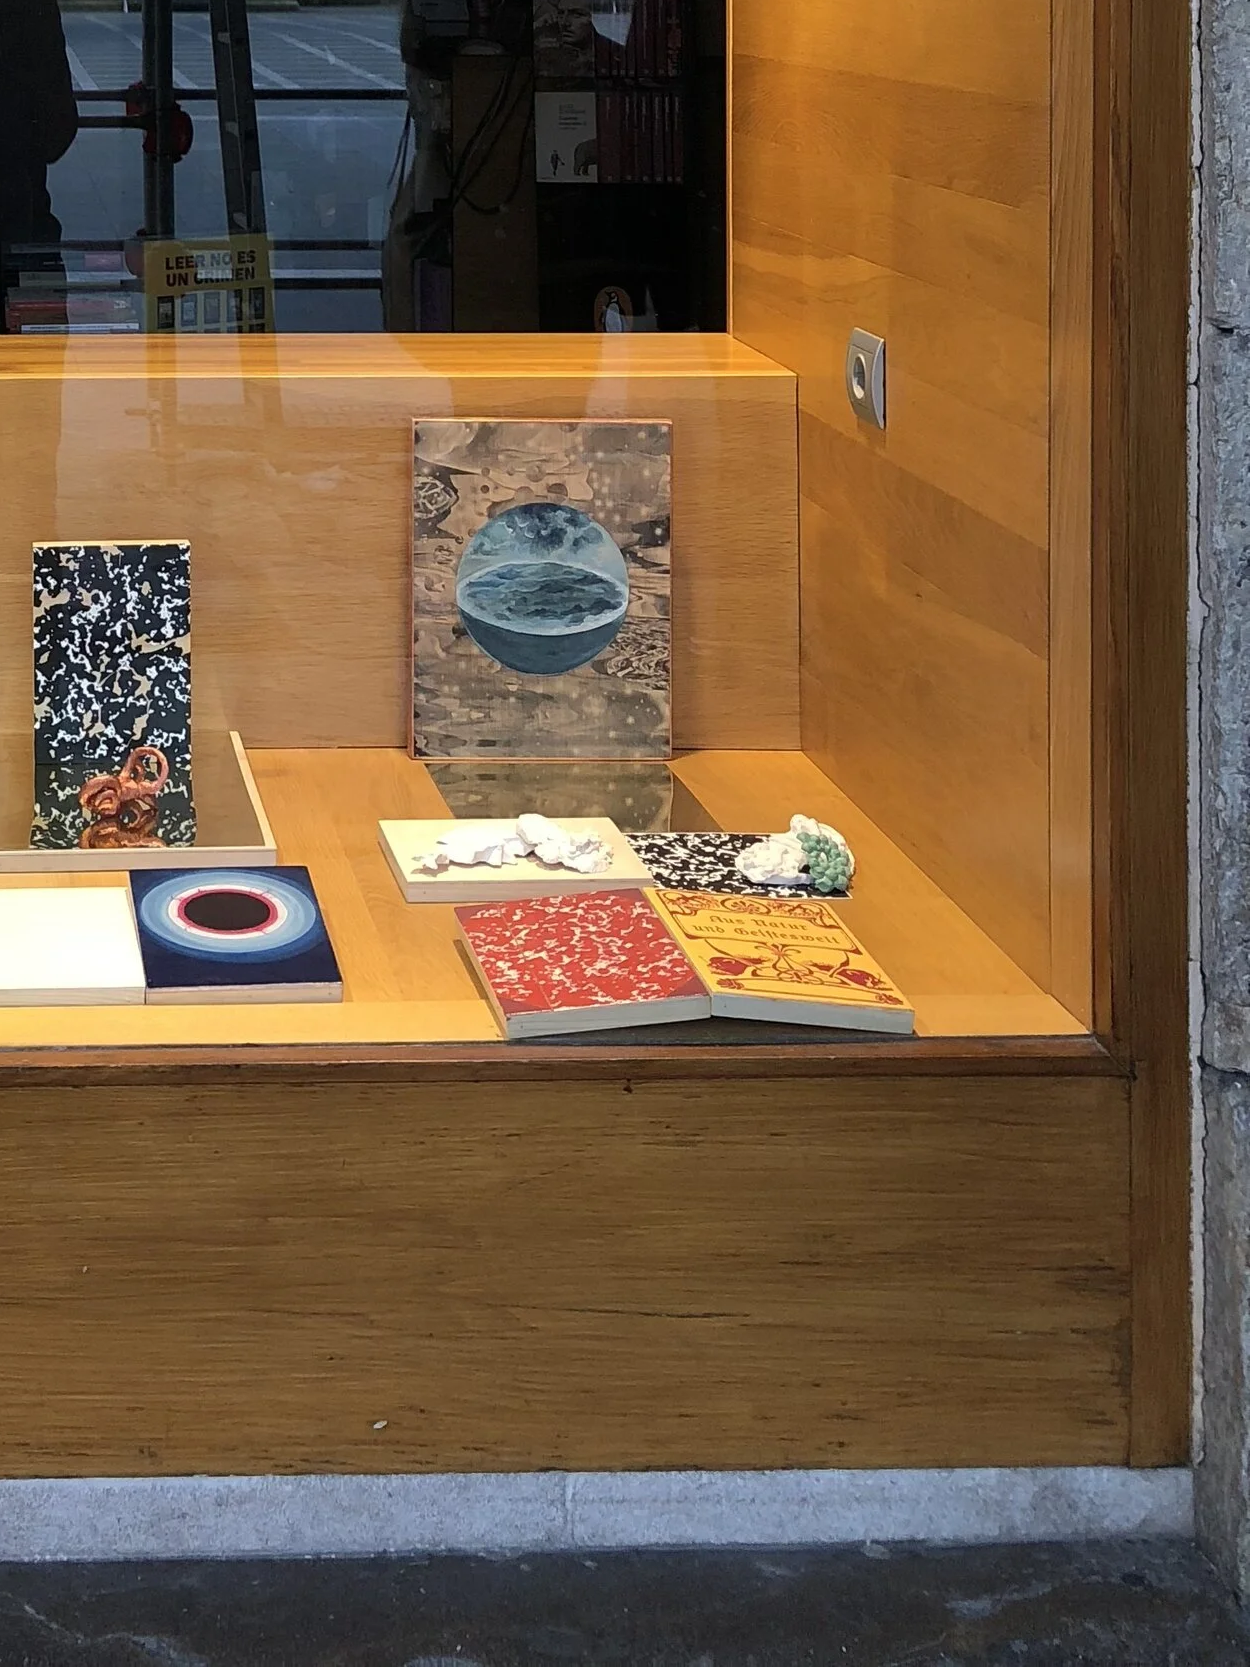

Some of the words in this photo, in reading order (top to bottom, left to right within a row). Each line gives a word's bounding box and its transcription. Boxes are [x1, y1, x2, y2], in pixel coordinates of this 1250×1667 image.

[165, 254, 206, 271] LEER
[210, 252, 232, 267] NO
[237, 250, 256, 264] ES
[166, 272, 188, 287] UN
[194, 266, 255, 284] CRIMEN
[693, 924, 725, 934] und
[709, 915, 745, 924] Aus
[751, 918, 807, 931] Natur
